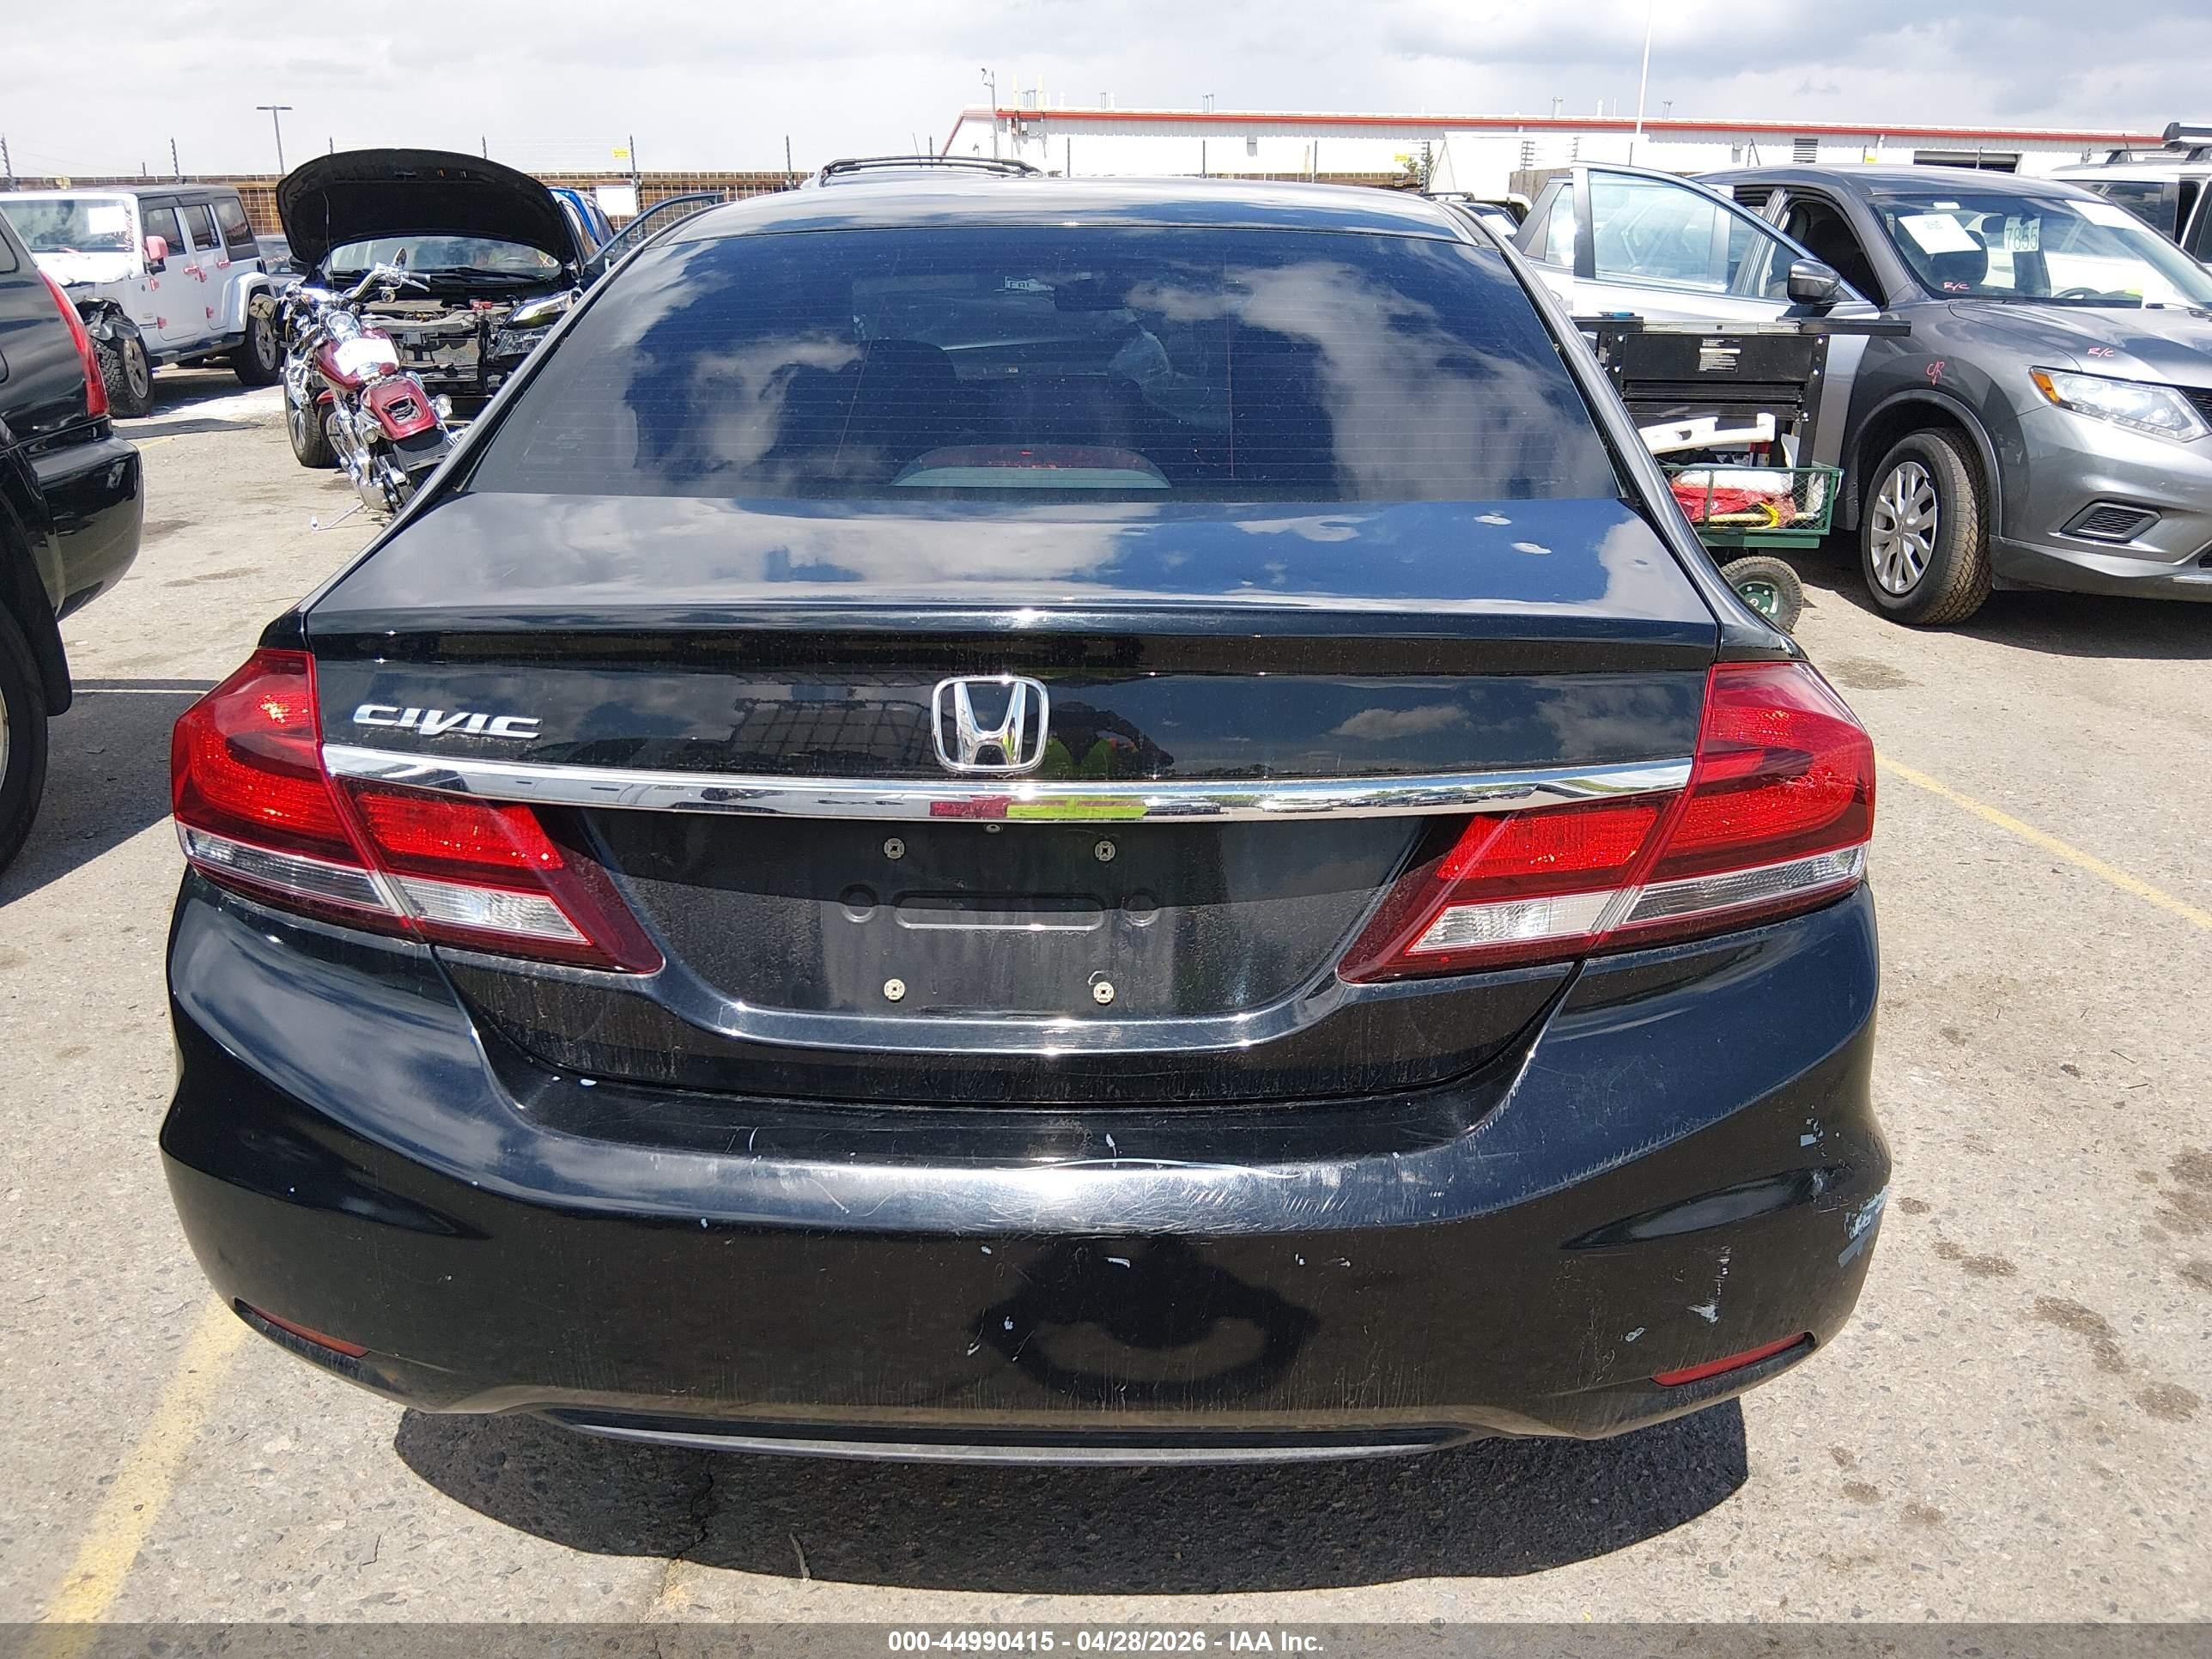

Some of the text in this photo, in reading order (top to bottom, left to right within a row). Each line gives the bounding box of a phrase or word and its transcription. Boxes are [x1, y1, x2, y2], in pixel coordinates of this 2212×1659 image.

[2005, 226, 2039, 251] 7855
[1943, 282, 1971, 291] R/C
[2087, 347, 2116, 358] R/C
[353, 704, 542, 739] CIVIC
